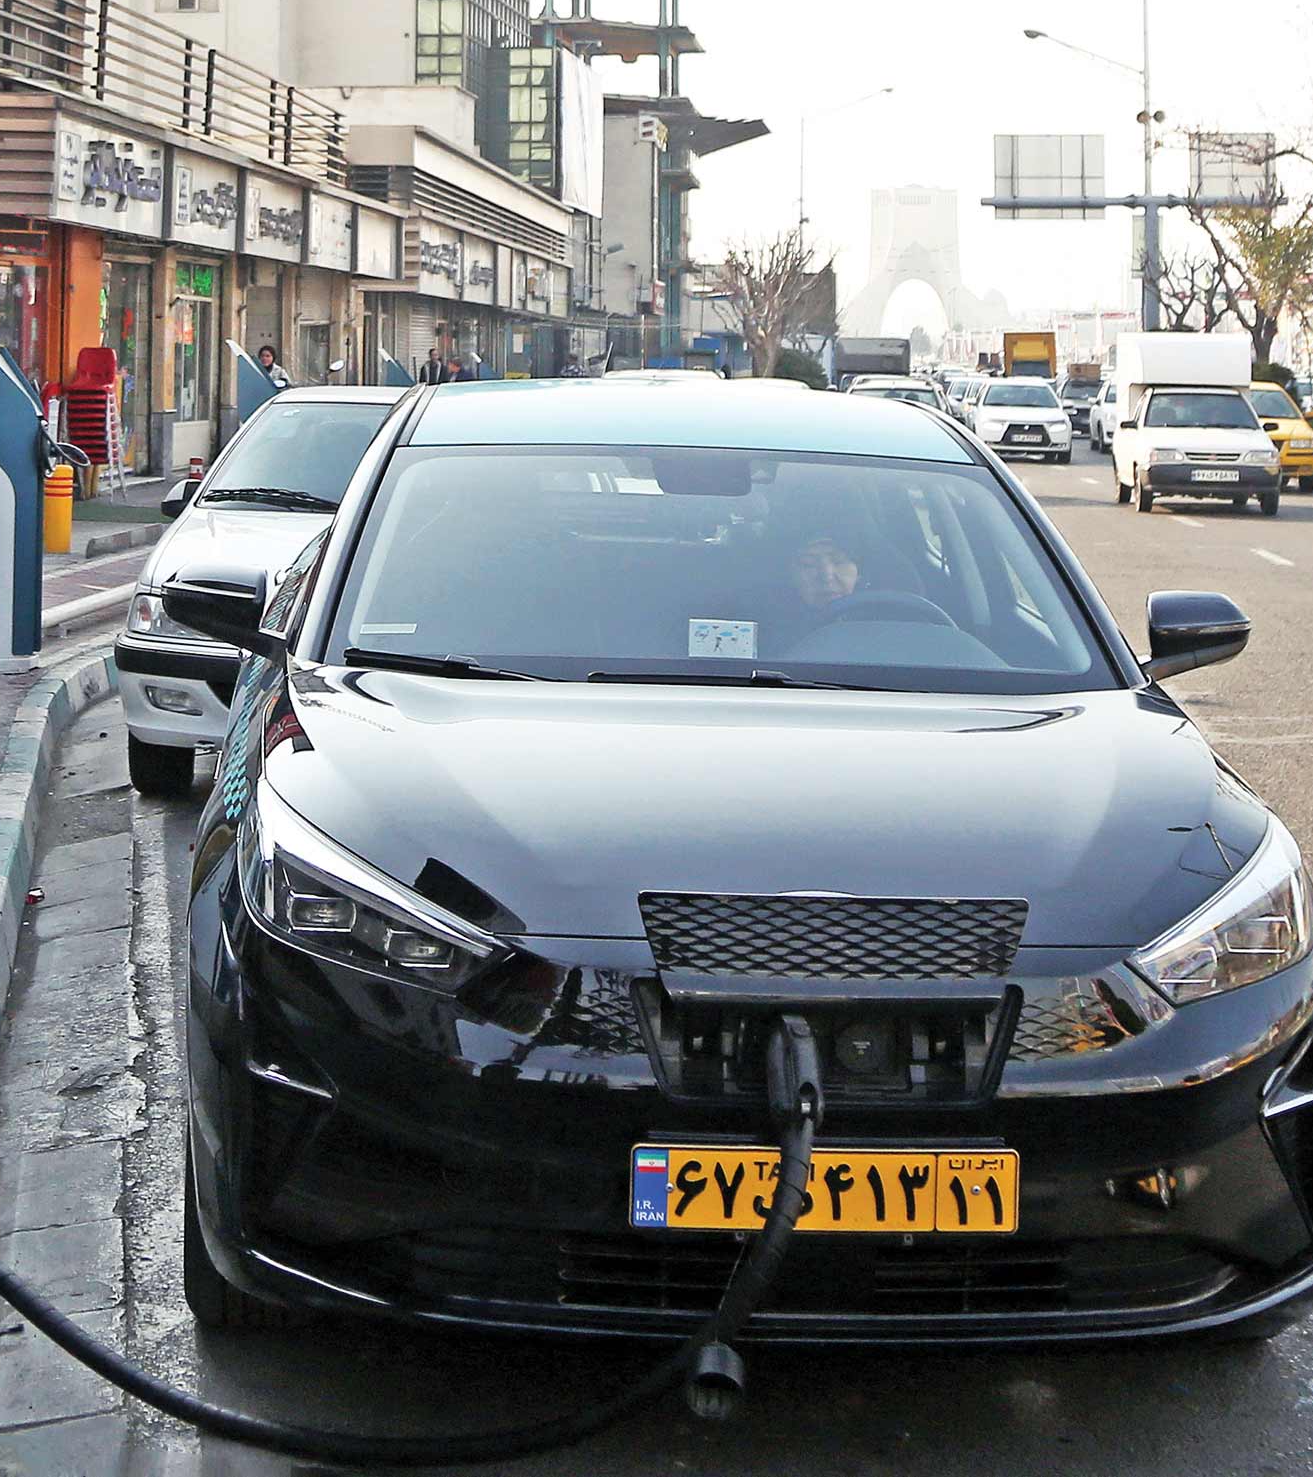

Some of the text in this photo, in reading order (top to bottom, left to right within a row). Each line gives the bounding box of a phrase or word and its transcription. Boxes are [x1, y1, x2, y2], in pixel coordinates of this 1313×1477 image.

[948, 1158, 1004, 1170] ایران
[753, 1161, 815, 1182] TAI
[675, 1160, 745, 1219] ۶۷
[824, 1163, 930, 1222] ۴۱۳
[949, 1175, 1004, 1225] ۱۱
[636, 1200, 655, 1211] I.R.
[636, 1211, 665, 1222] IRAN
